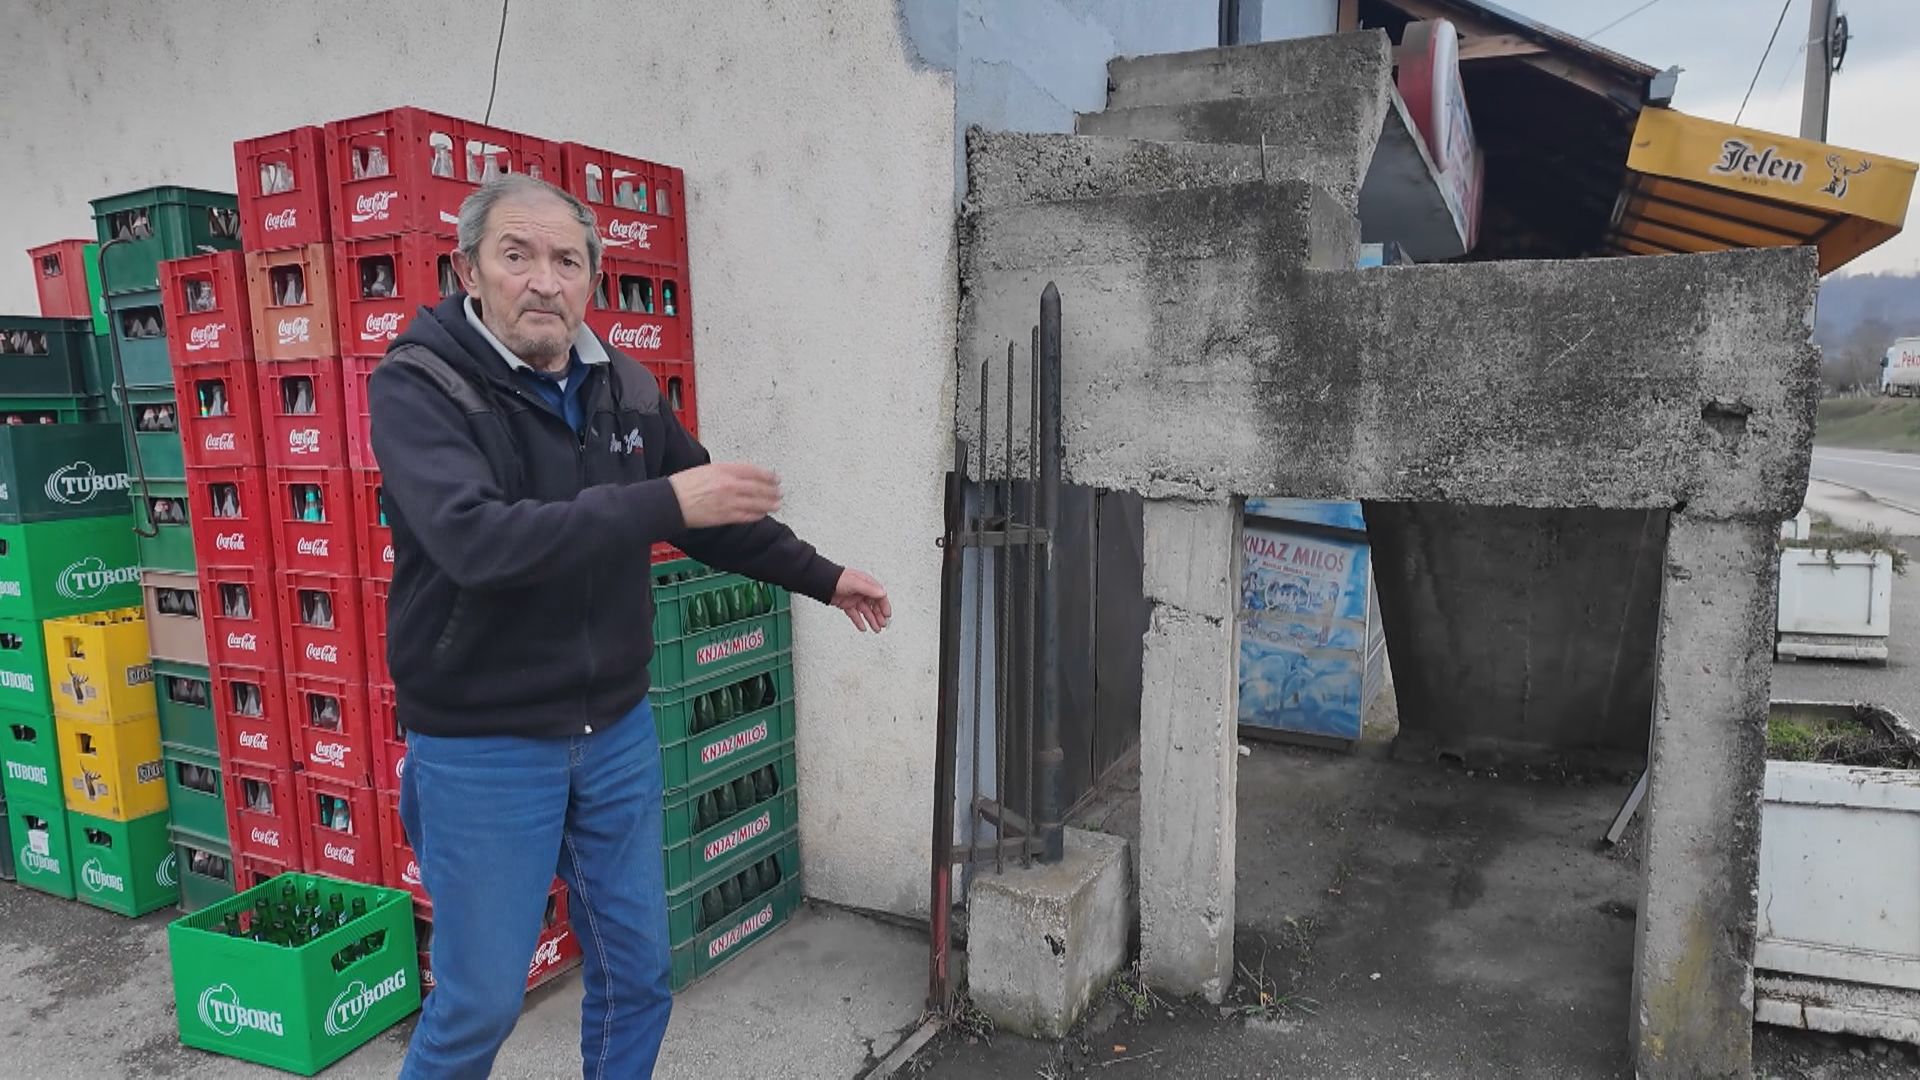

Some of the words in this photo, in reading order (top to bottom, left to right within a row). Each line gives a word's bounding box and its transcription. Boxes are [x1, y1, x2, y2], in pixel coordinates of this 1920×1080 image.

[1713, 140, 1803, 182] Jelen
[61, 472, 131, 496] TUBOR
[1242, 533, 1290, 562] KNJAZ
[72, 565, 141, 591] TUBOR
[697, 641, 731, 665] KNJAZ
[702, 735, 735, 763] KNJAZ
[6, 760, 48, 786] TUBORG
[704, 830, 738, 862] KNJAZ
[26, 851, 61, 875] TUBORG
[88, 868, 124, 892] TUBORG
[709, 926, 742, 959] KNJAZ
[337, 968, 407, 1024] TUBORG
[209, 998, 284, 1037] TUBORG
